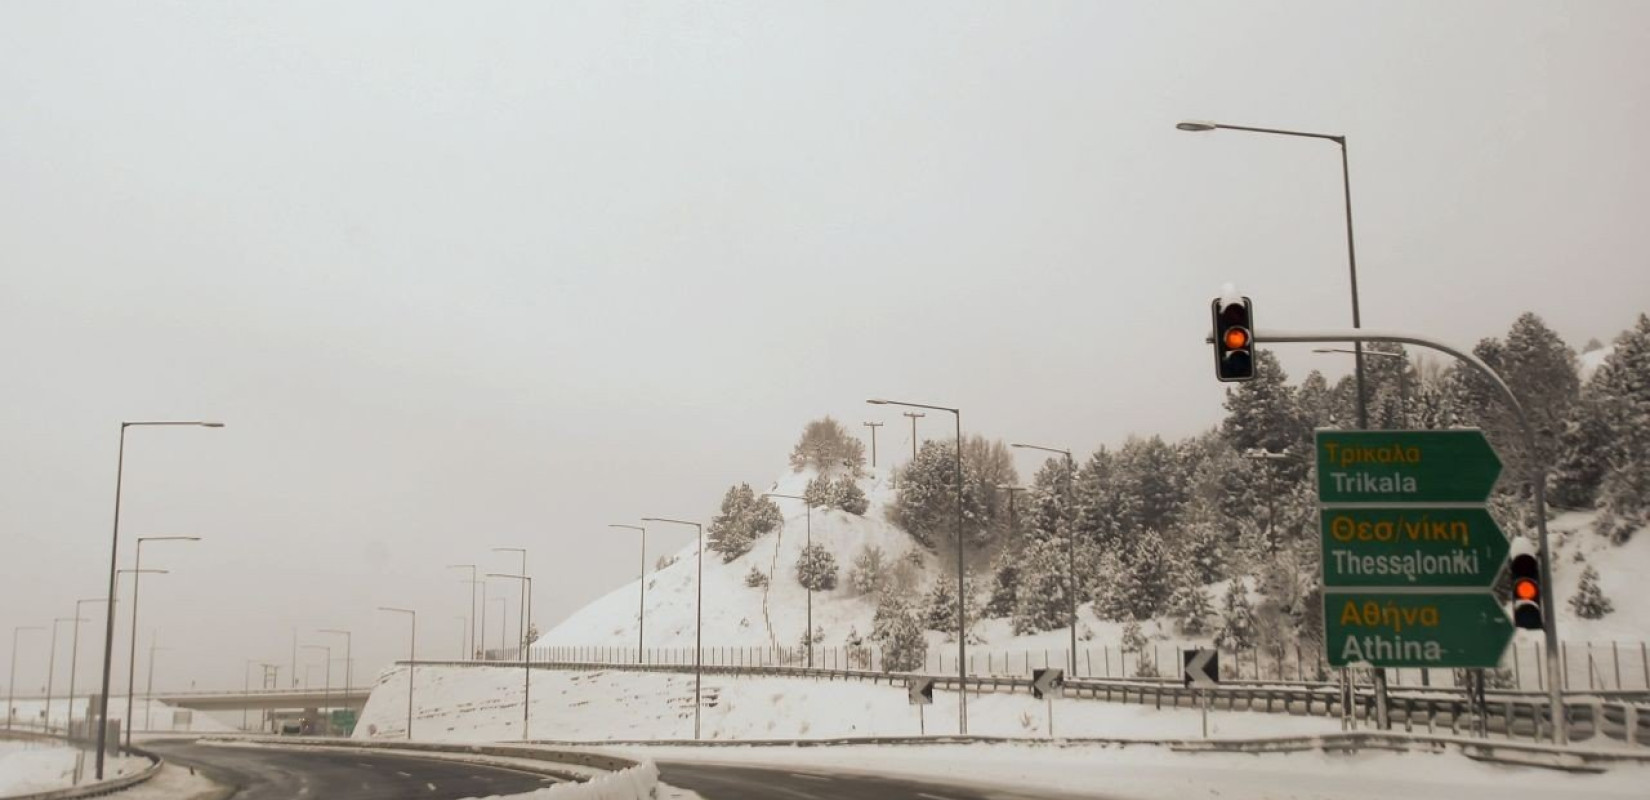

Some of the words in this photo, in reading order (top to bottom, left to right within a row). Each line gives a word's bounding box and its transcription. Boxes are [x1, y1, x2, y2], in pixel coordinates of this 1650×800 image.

[1330, 472, 1417, 493] Trikala
[1332, 550, 1480, 575] Thessaloniki
[1341, 599, 1439, 631] Αθήνα
[1341, 635, 1441, 661] Athina
